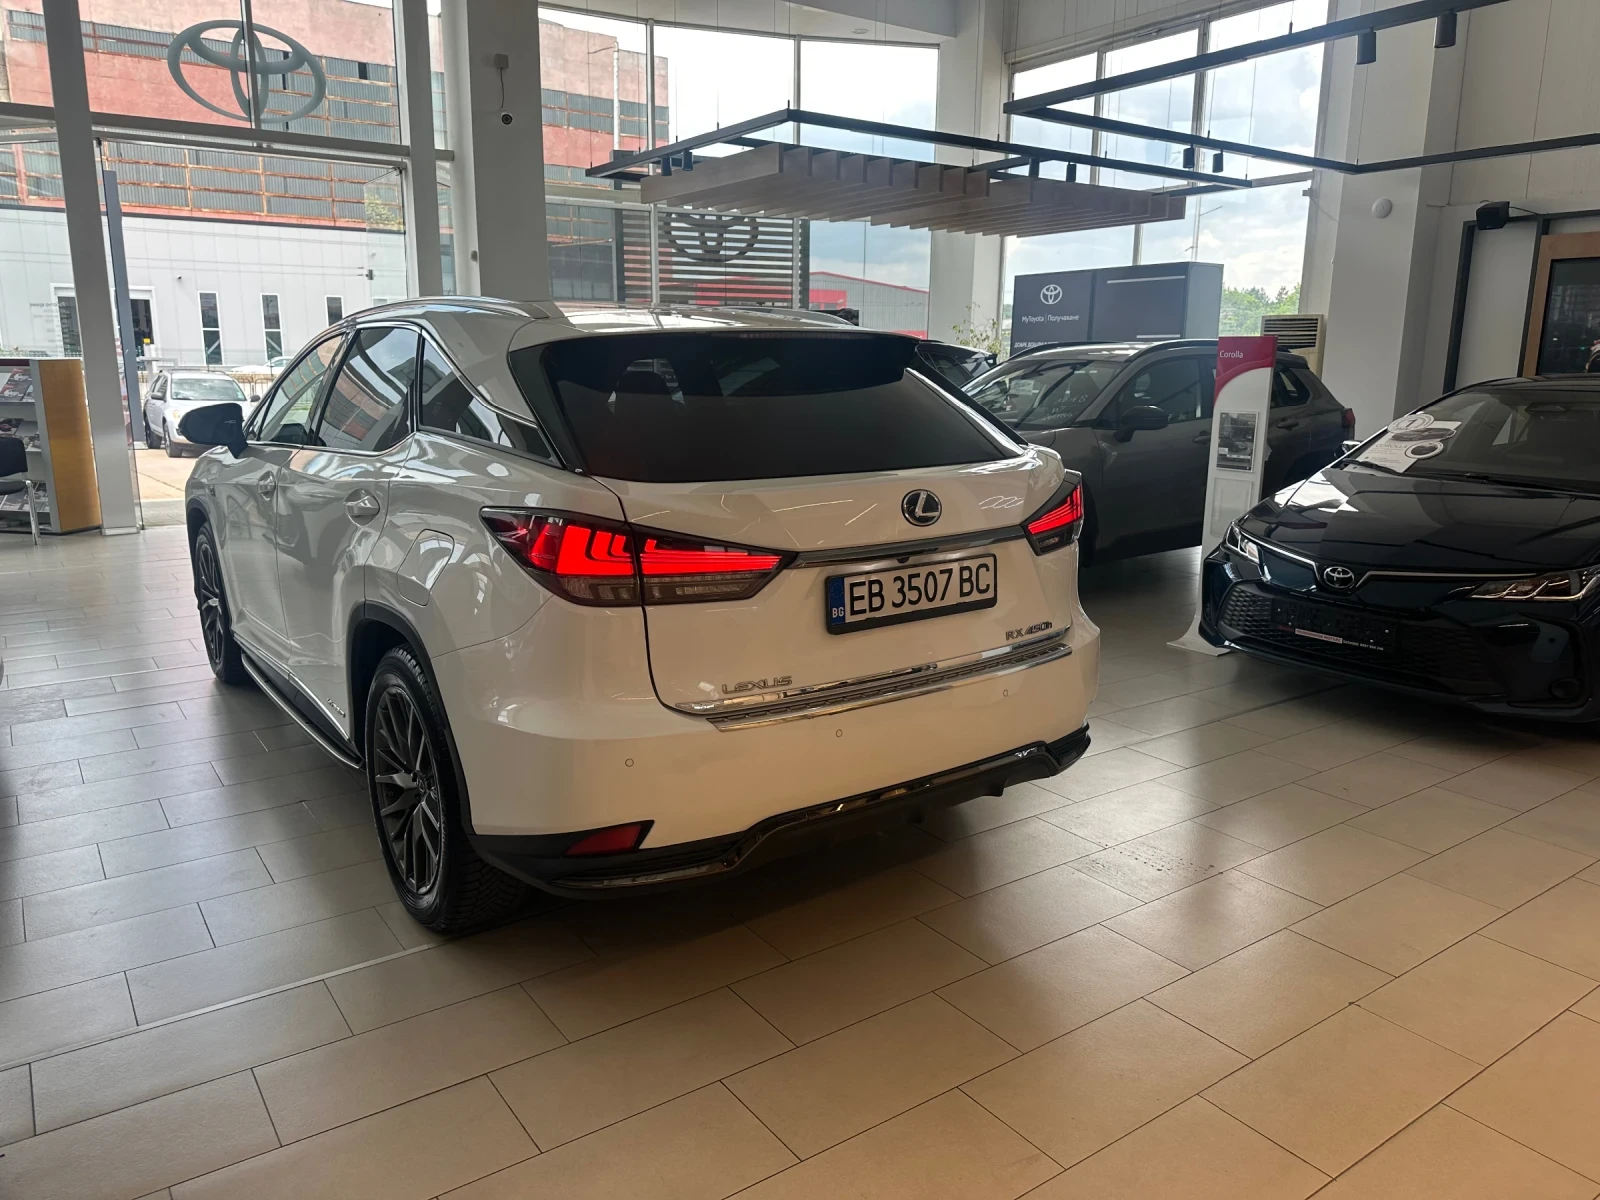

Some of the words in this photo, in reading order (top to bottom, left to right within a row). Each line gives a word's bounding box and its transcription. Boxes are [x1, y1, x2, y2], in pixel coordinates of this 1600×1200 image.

[1021, 315, 1044, 323] MyToyota
[1047, 314, 1080, 323] Получаване
[1219, 350, 1244, 359] Corolla
[849, 579, 884, 616] EB
[891, 568, 953, 609] 3507
[960, 564, 990, 597] BC
[831, 606, 844, 618] BG
[1005, 627, 1024, 641] RX
[1024, 620, 1053, 636] 450h
[721, 675, 793, 694] LEXUS
